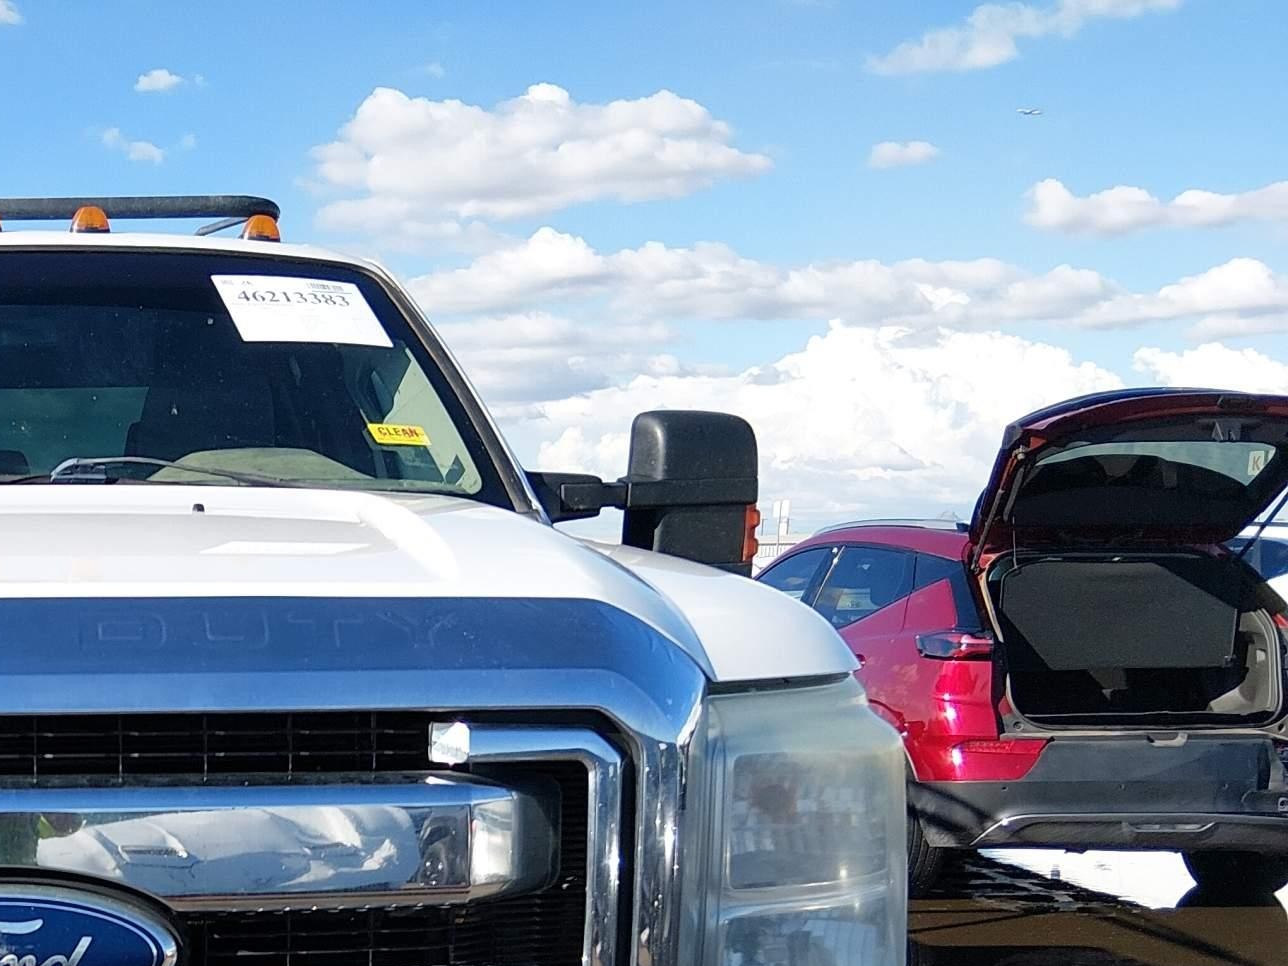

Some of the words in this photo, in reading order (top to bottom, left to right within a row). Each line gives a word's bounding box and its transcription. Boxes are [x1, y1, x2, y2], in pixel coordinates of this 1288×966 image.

[237, 290, 351, 307] 46213383
[377, 426, 420, 438] CLEAN
[79, 609, 458, 650] DUTY
